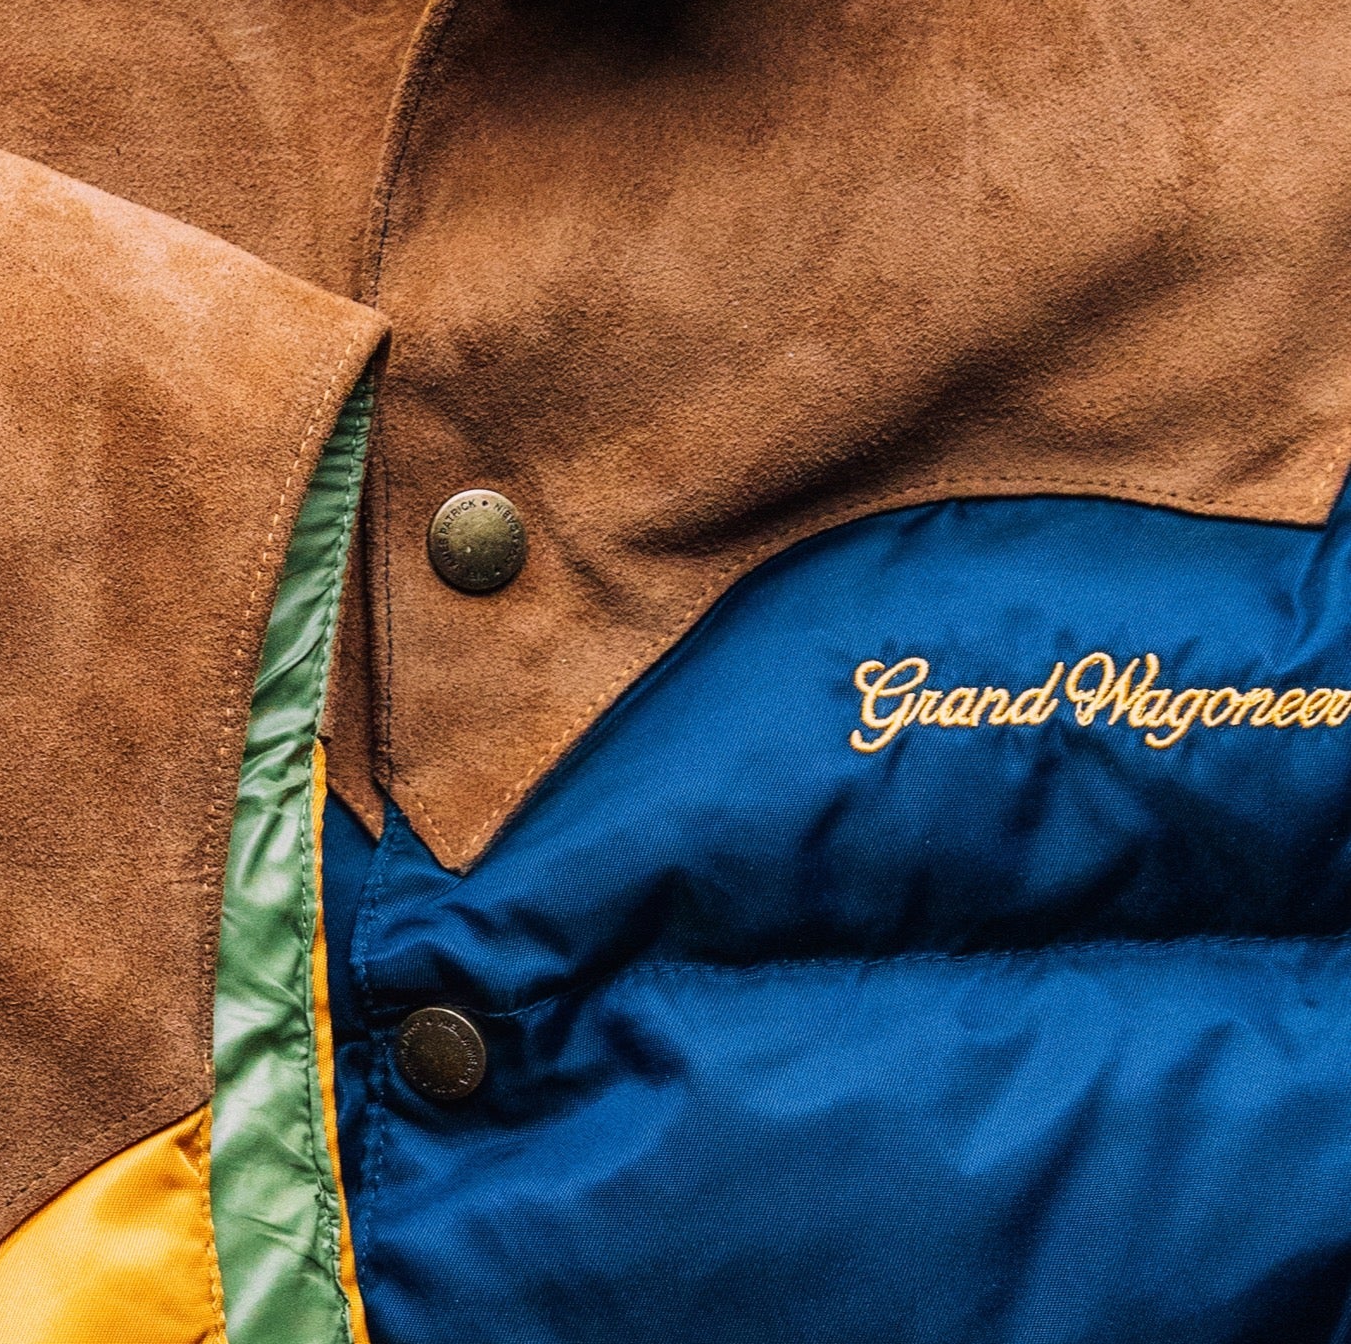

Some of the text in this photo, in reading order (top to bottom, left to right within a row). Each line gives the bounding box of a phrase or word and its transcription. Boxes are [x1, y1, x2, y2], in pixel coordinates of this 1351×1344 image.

[438, 499, 477, 535] PATRICK
[849, 650, 1351, 753] Grand Wagoneer
